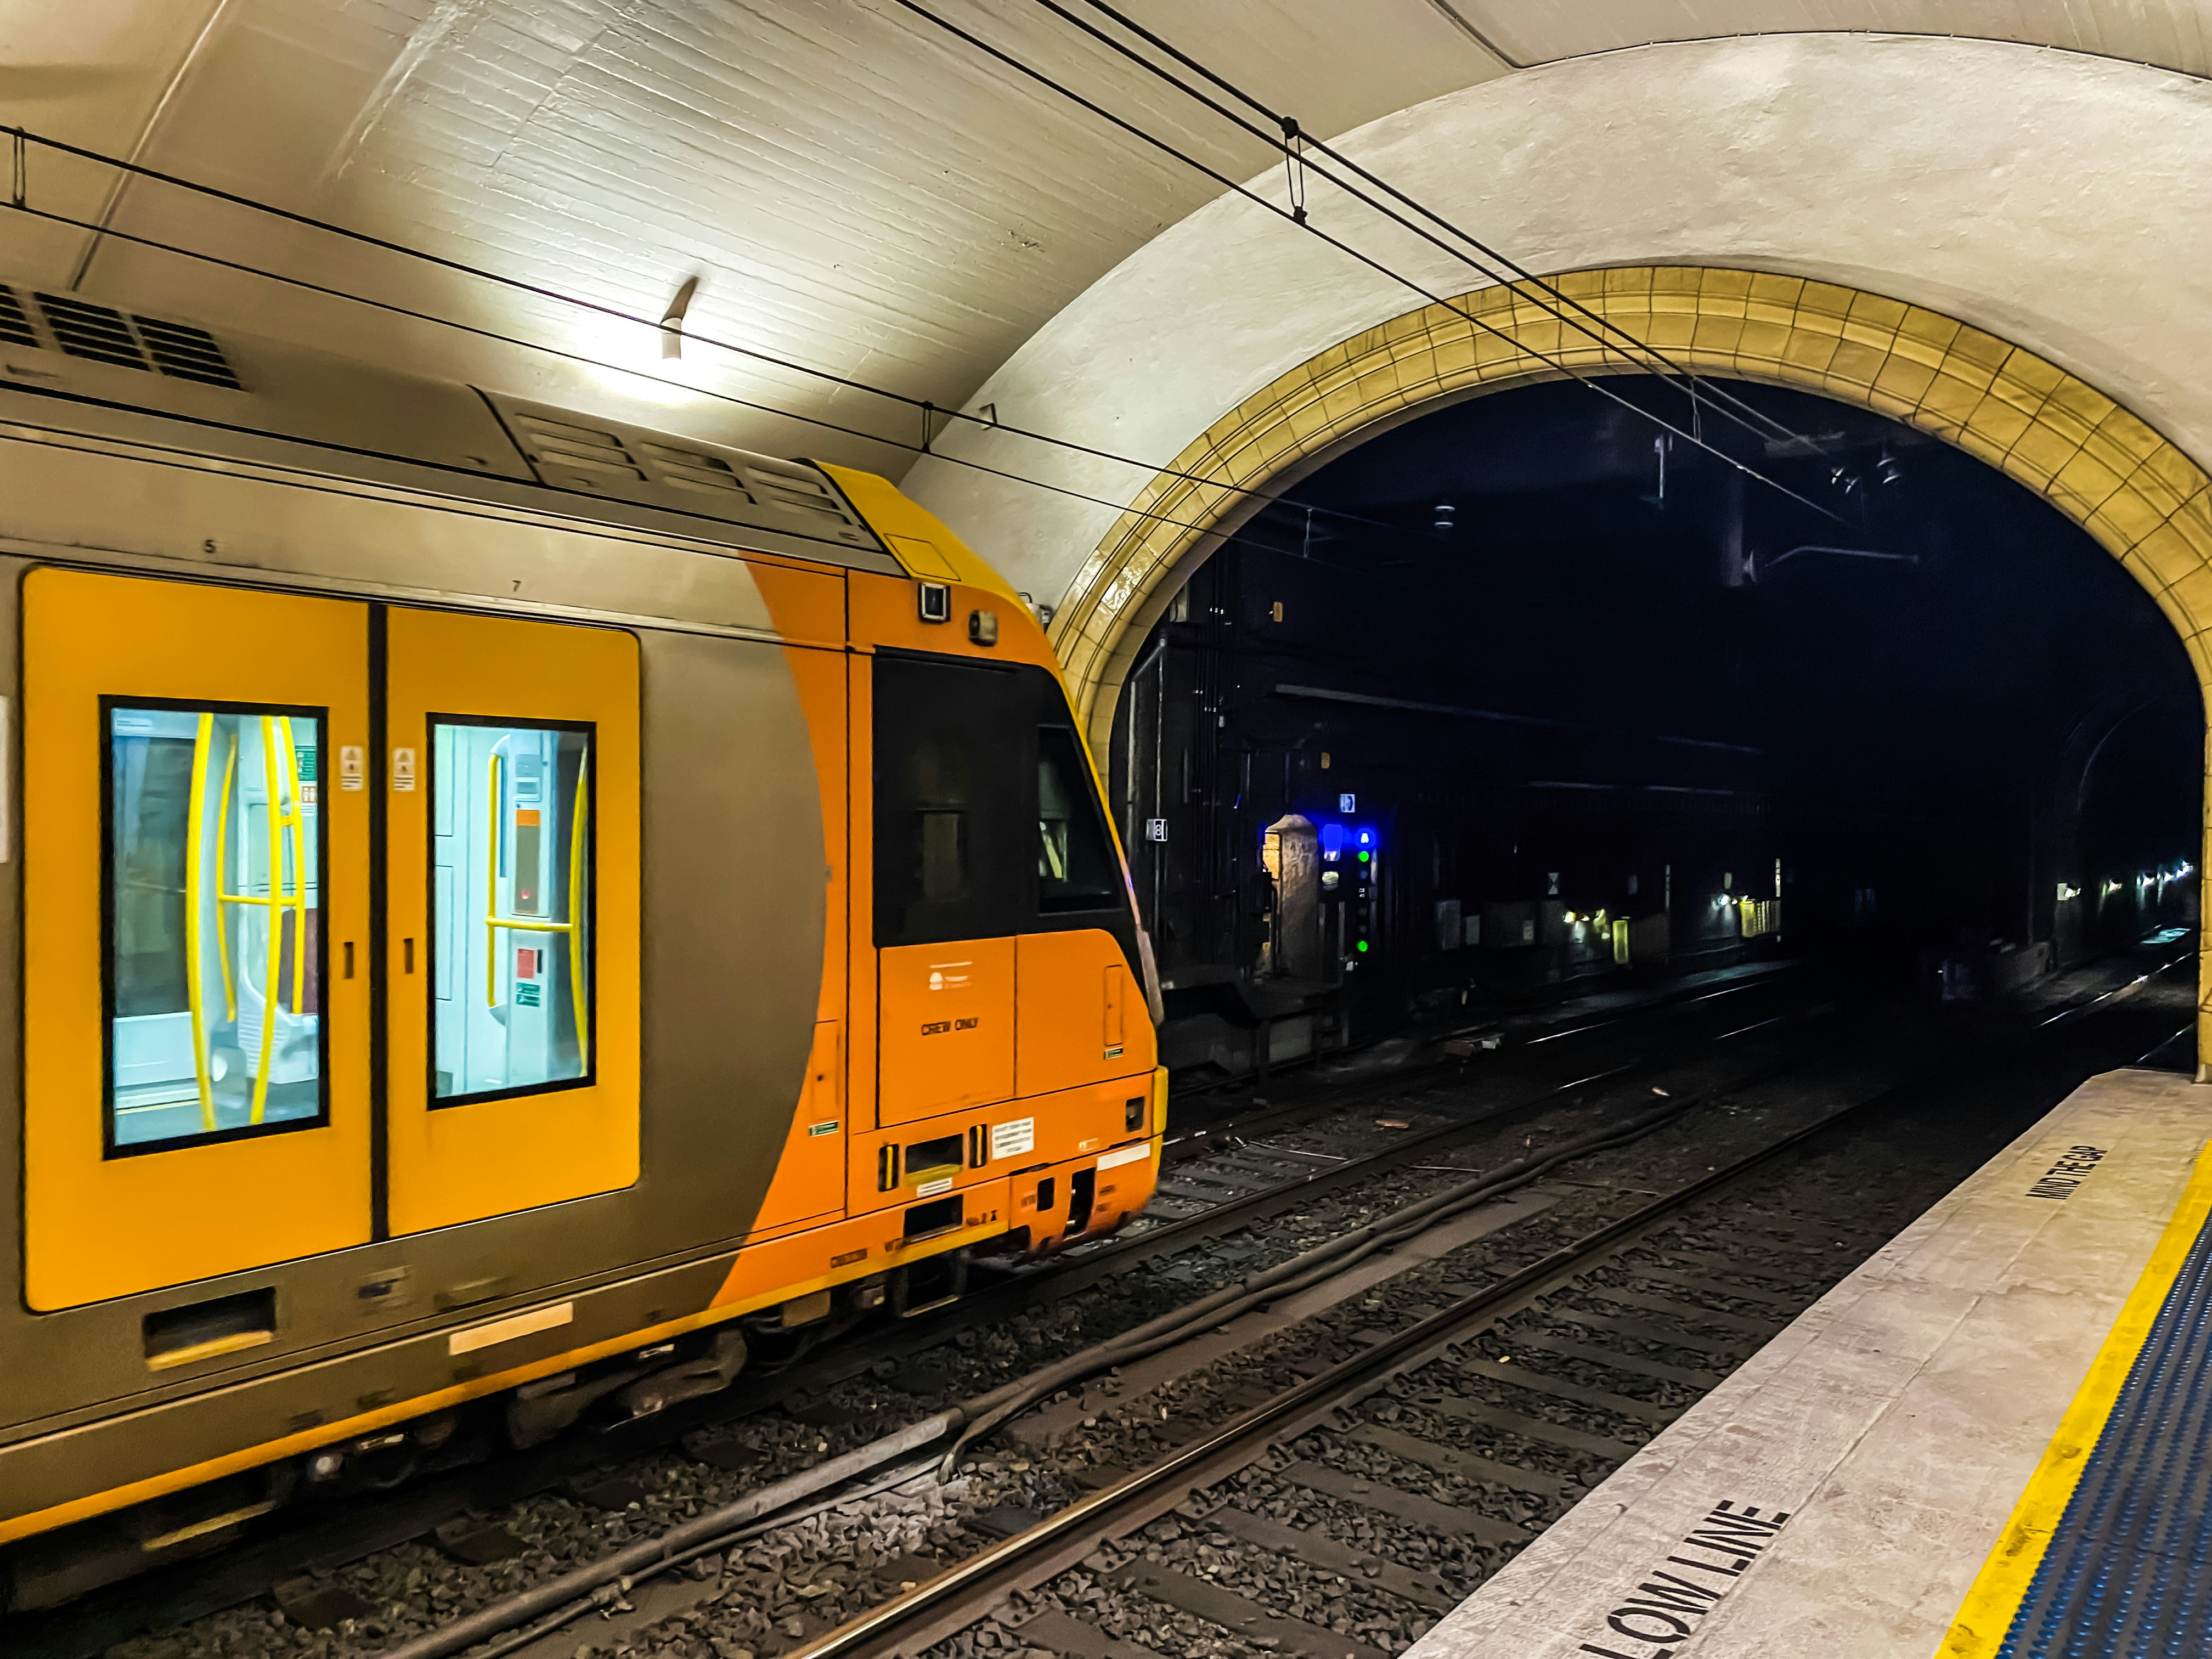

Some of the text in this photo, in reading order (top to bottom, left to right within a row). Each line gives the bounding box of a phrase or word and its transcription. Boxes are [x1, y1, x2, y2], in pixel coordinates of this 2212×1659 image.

[512, 580, 522, 592] 7
[921, 1017, 979, 1036] CREW ONLY
[2024, 1146, 2108, 1200] MIND THE GAP
[1667, 1500, 1791, 1577] LINE
